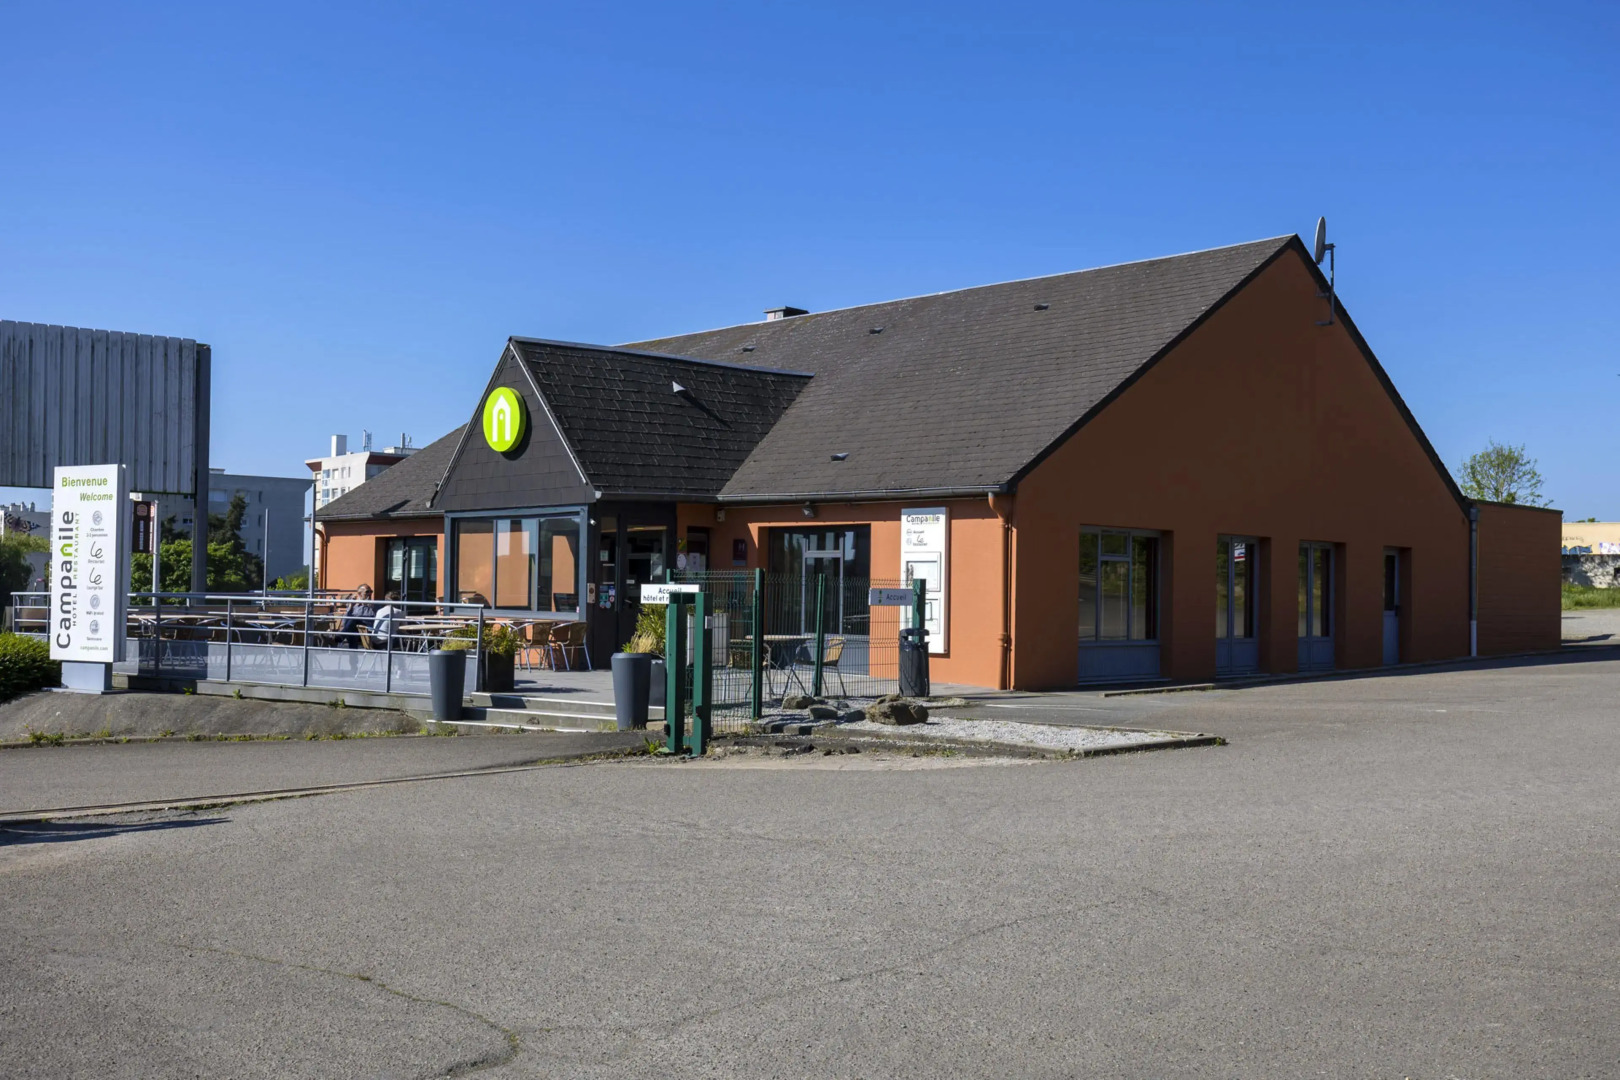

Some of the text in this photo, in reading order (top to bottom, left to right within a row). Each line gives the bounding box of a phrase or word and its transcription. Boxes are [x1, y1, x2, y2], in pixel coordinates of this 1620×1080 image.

[61, 477, 108, 487] Bienvenue
[80, 492, 113, 501] Welcome
[906, 515, 941, 525] Campanile
[56, 511, 77, 649] Campanile
[643, 594, 658, 602] hôtel
[885, 593, 907, 601] Accueil
